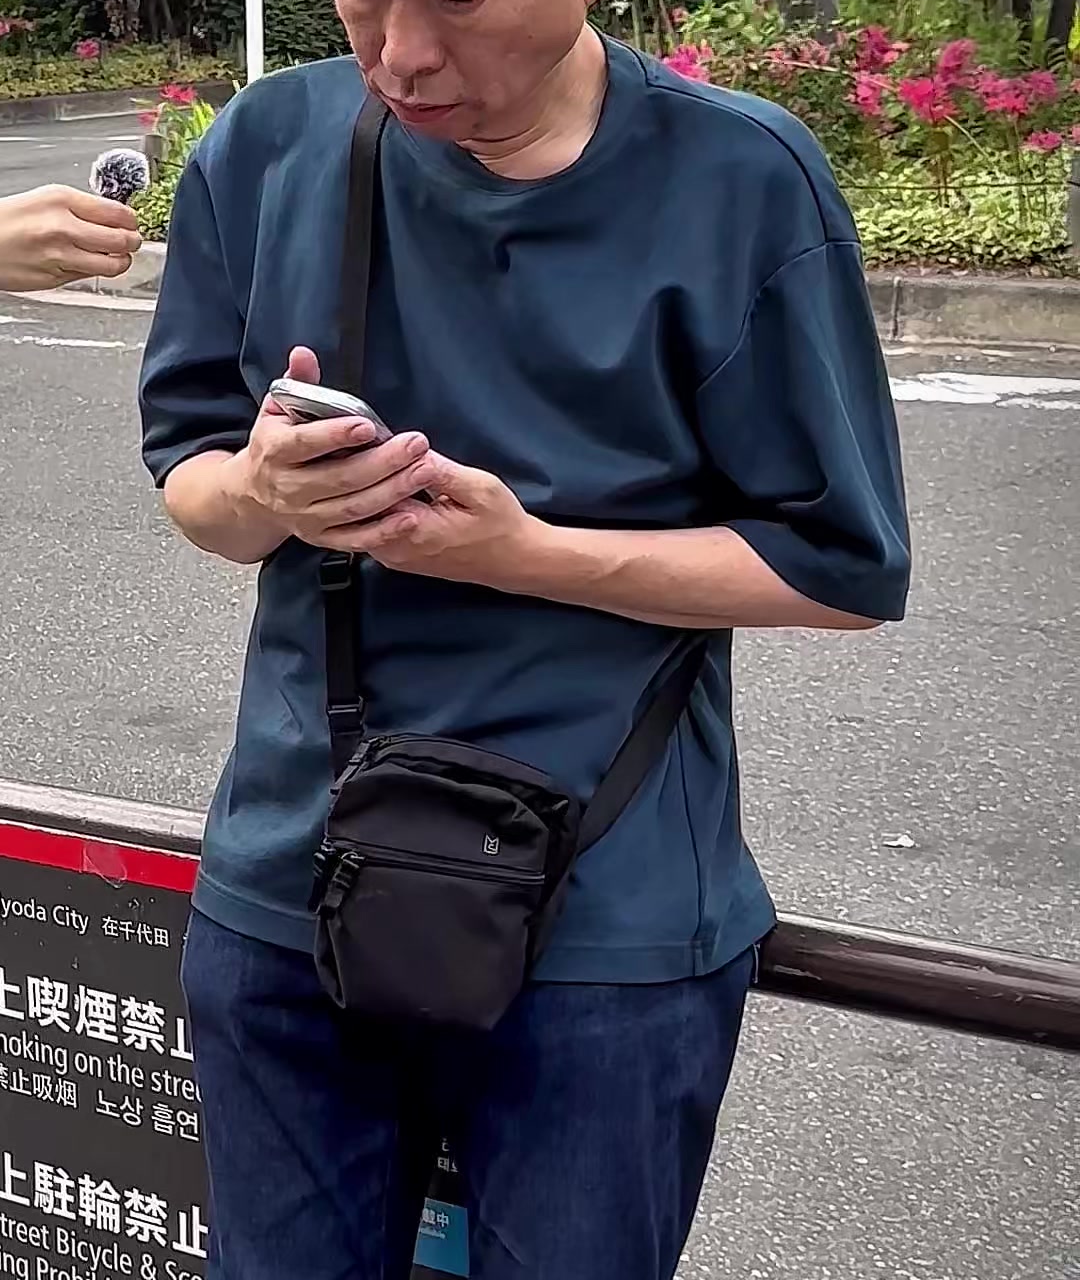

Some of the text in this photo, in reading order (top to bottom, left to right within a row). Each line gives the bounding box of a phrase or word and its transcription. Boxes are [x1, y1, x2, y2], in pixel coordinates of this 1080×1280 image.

[53, 906, 89, 935] City
[102, 916, 169, 947] 在千代田
[74, 1052, 102, 1078] on
[107, 1054, 145, 1088] the
[96, 1090, 200, 1141] 노상 흡연
[56, 1227, 132, 1275] Bicycle
